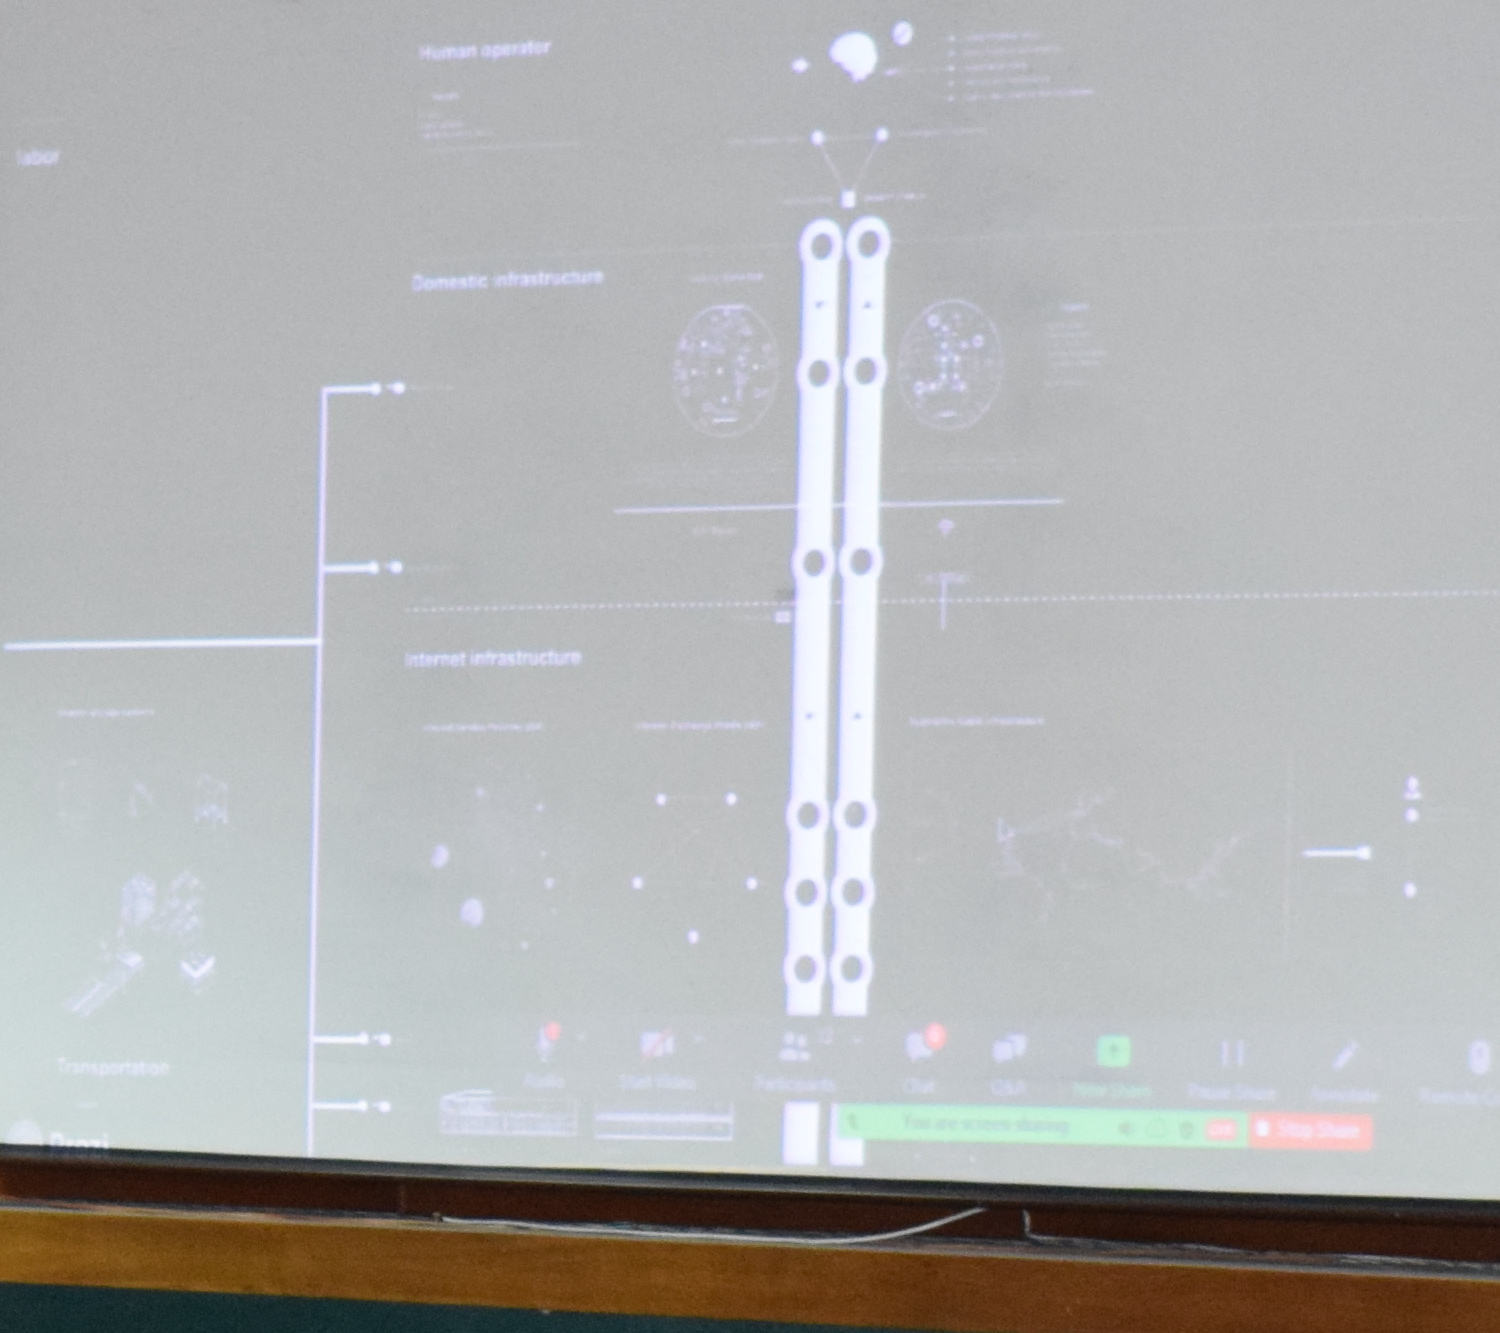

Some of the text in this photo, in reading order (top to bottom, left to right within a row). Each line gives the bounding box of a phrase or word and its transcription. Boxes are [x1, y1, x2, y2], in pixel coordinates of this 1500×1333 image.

[419, 39, 553, 61] Human operator
[411, 269, 605, 292] Domestic infrastructure
[405, 650, 583, 668] Internet infrastructure
[57, 1056, 171, 1077] Transportation
[902, 1113, 935, 1131] You
[937, 1118, 963, 1131] are
[966, 1118, 1012, 1133] screen
[1277, 1119, 1360, 1140] Stop Share
